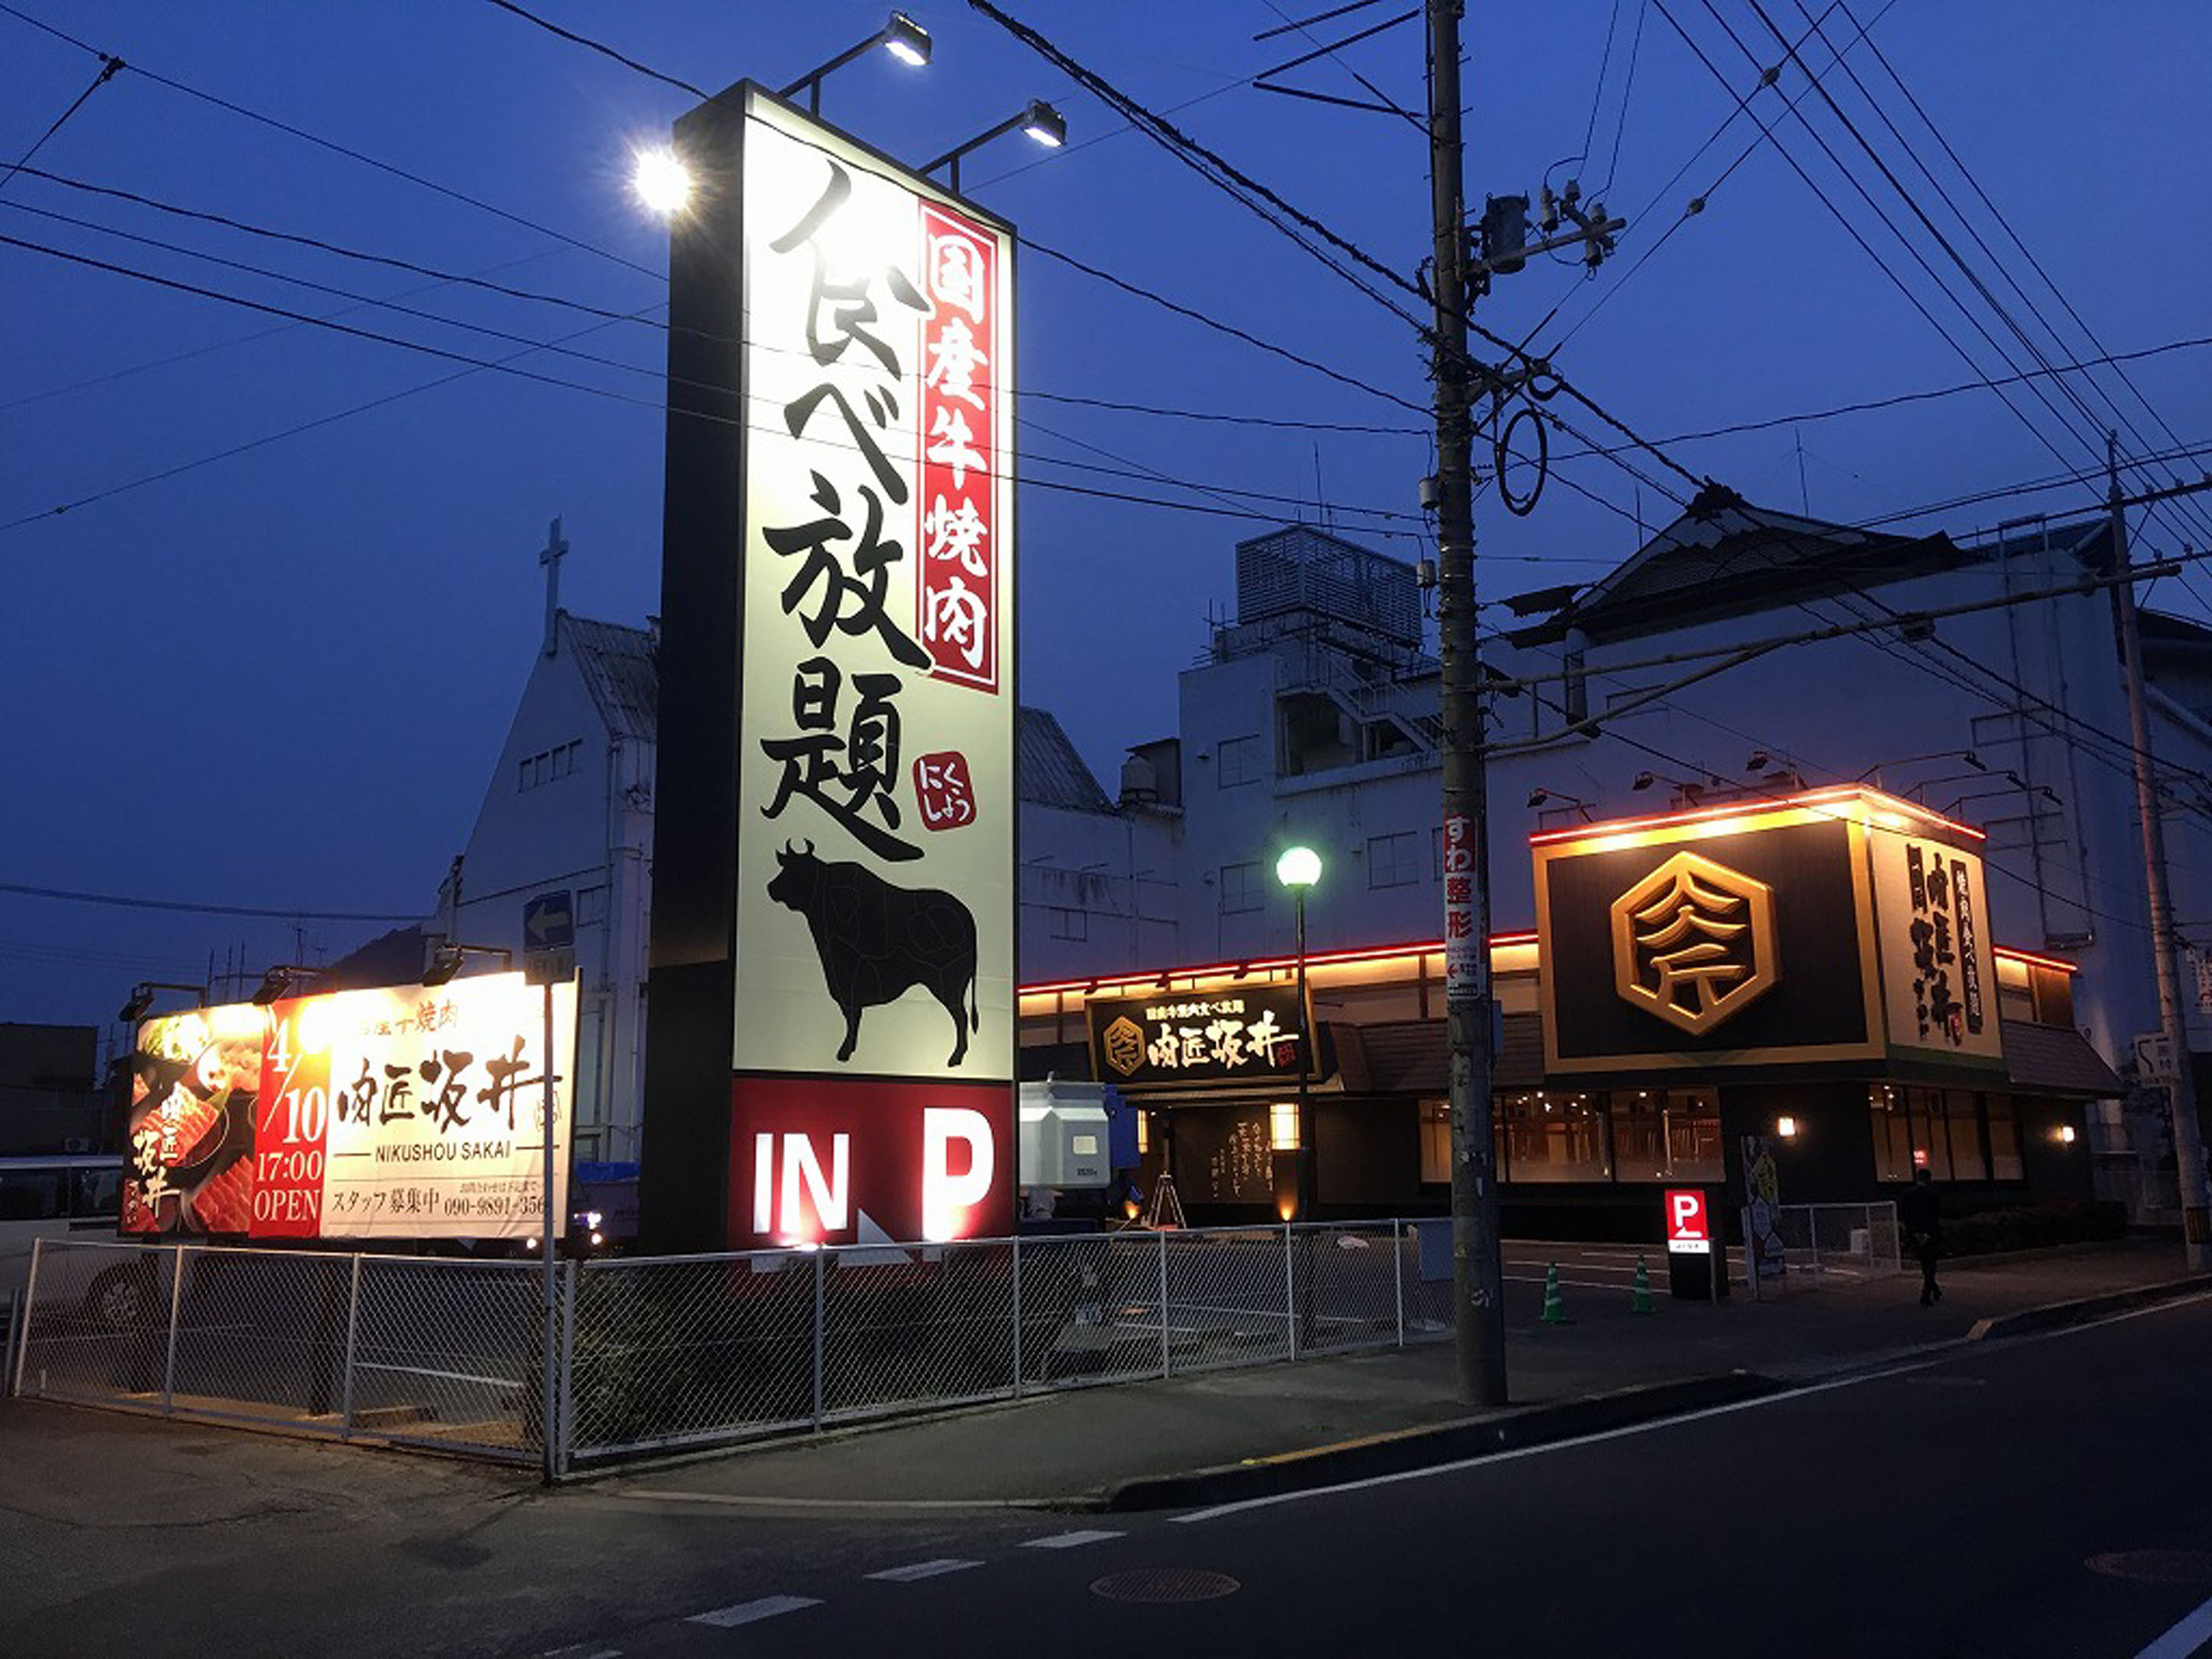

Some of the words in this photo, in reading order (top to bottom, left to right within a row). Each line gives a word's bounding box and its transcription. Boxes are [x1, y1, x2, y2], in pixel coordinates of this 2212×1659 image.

[923, 233, 992, 668] 国産牛焼肉
[760, 158, 927, 862] 食べ放題
[920, 760, 963, 790] にく
[1445, 816, 1474, 939] すわ整形
[1147, 1010, 1300, 1069] 肉匠坂井
[336, 1034, 565, 1134] 肉匠坂井
[257, 1151, 323, 1184] 17:00
[375, 1143, 458, 1164] NIKUSHOU
[461, 1140, 512, 1161] SAKAI
[922, 1107, 995, 1242] P
[254, 1187, 321, 1223] OPEN
[331, 1187, 440, 1214] スタッフ募集中
[753, 1133, 850, 1235] IN
[1674, 1196, 1698, 1227] P
